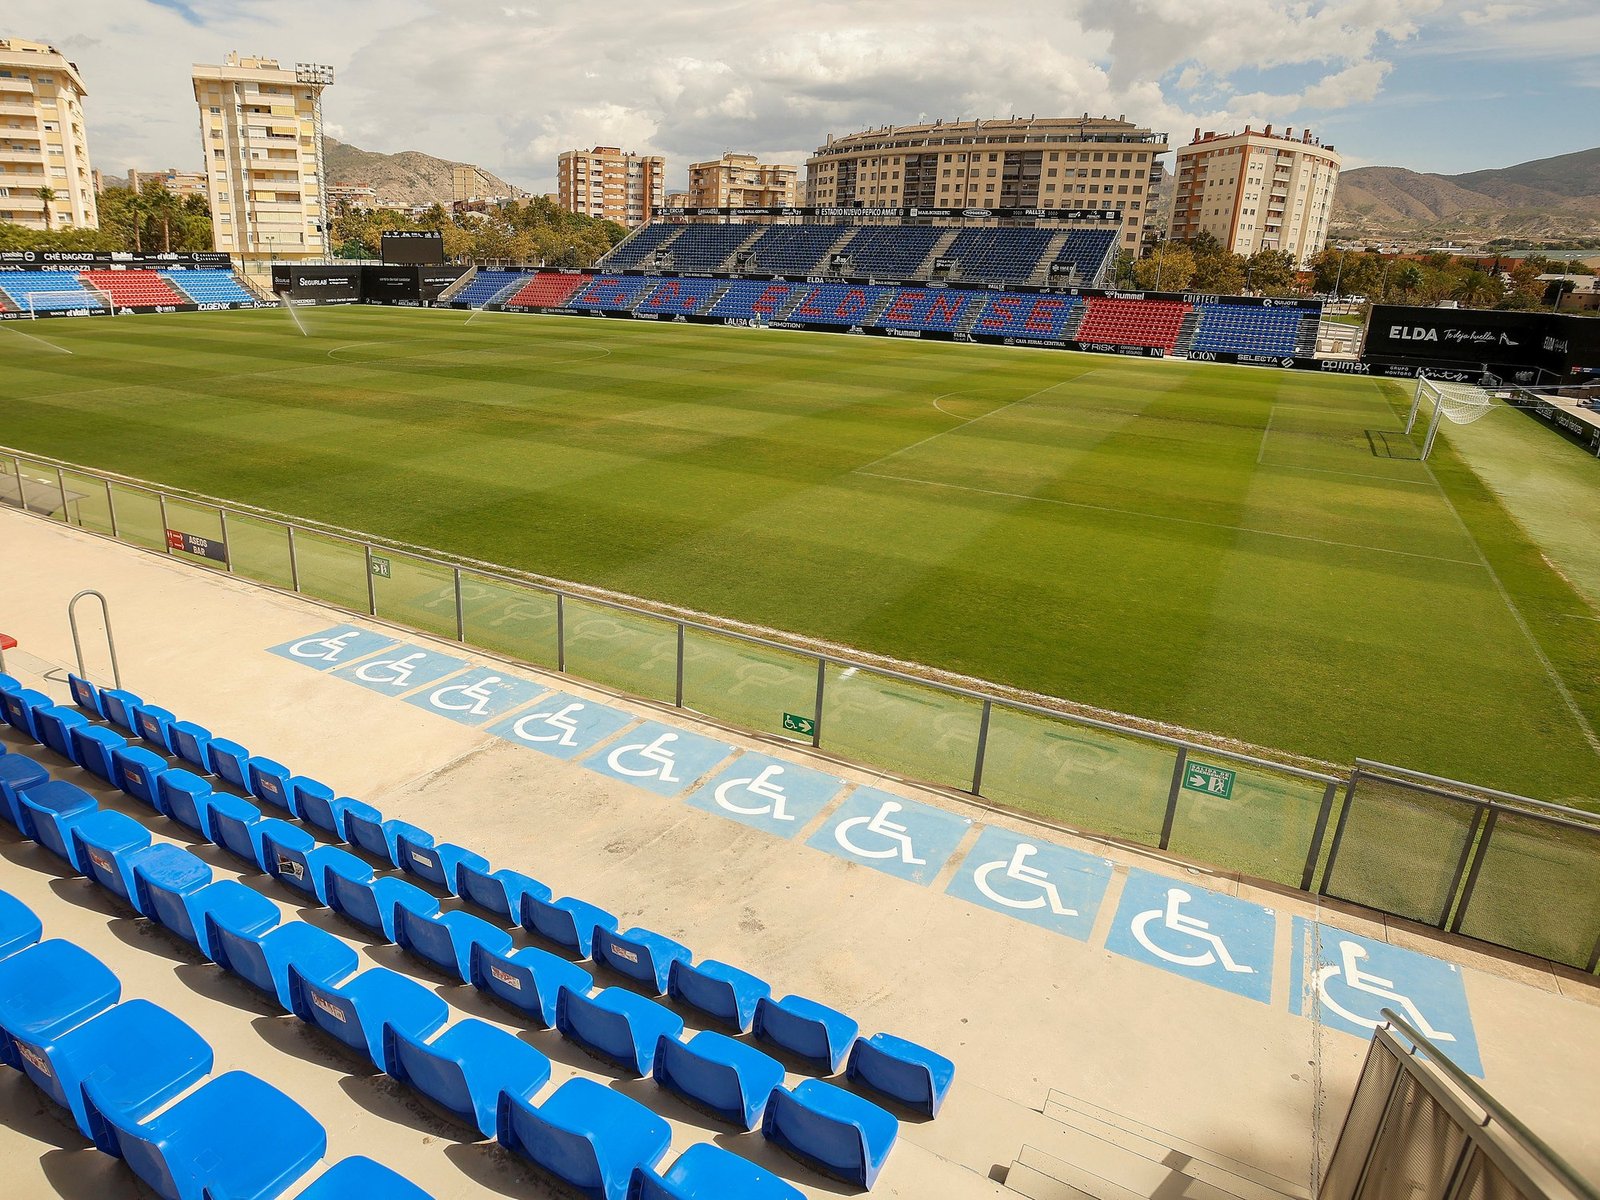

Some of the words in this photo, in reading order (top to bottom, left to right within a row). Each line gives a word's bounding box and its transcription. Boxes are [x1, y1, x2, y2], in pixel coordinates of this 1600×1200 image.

[821, 208, 843, 216] ESTADIO
[843, 208, 862, 216] NUEVO
[862, 208, 881, 216] PEPICO
[881, 208, 898, 216] AMAT
[61, 252, 94, 261] RAGAZZI
[299, 277, 328, 286] SEGURLAB
[807, 276, 824, 284] ELDA
[1114, 291, 1146, 301] hummel
[893, 328, 921, 338] hummel
[1388, 325, 1438, 341] ELDA
[1237, 354, 1279, 364] SELECTA
[189, 536, 208, 548] ASEOS
[193, 546, 206, 556] BAR
